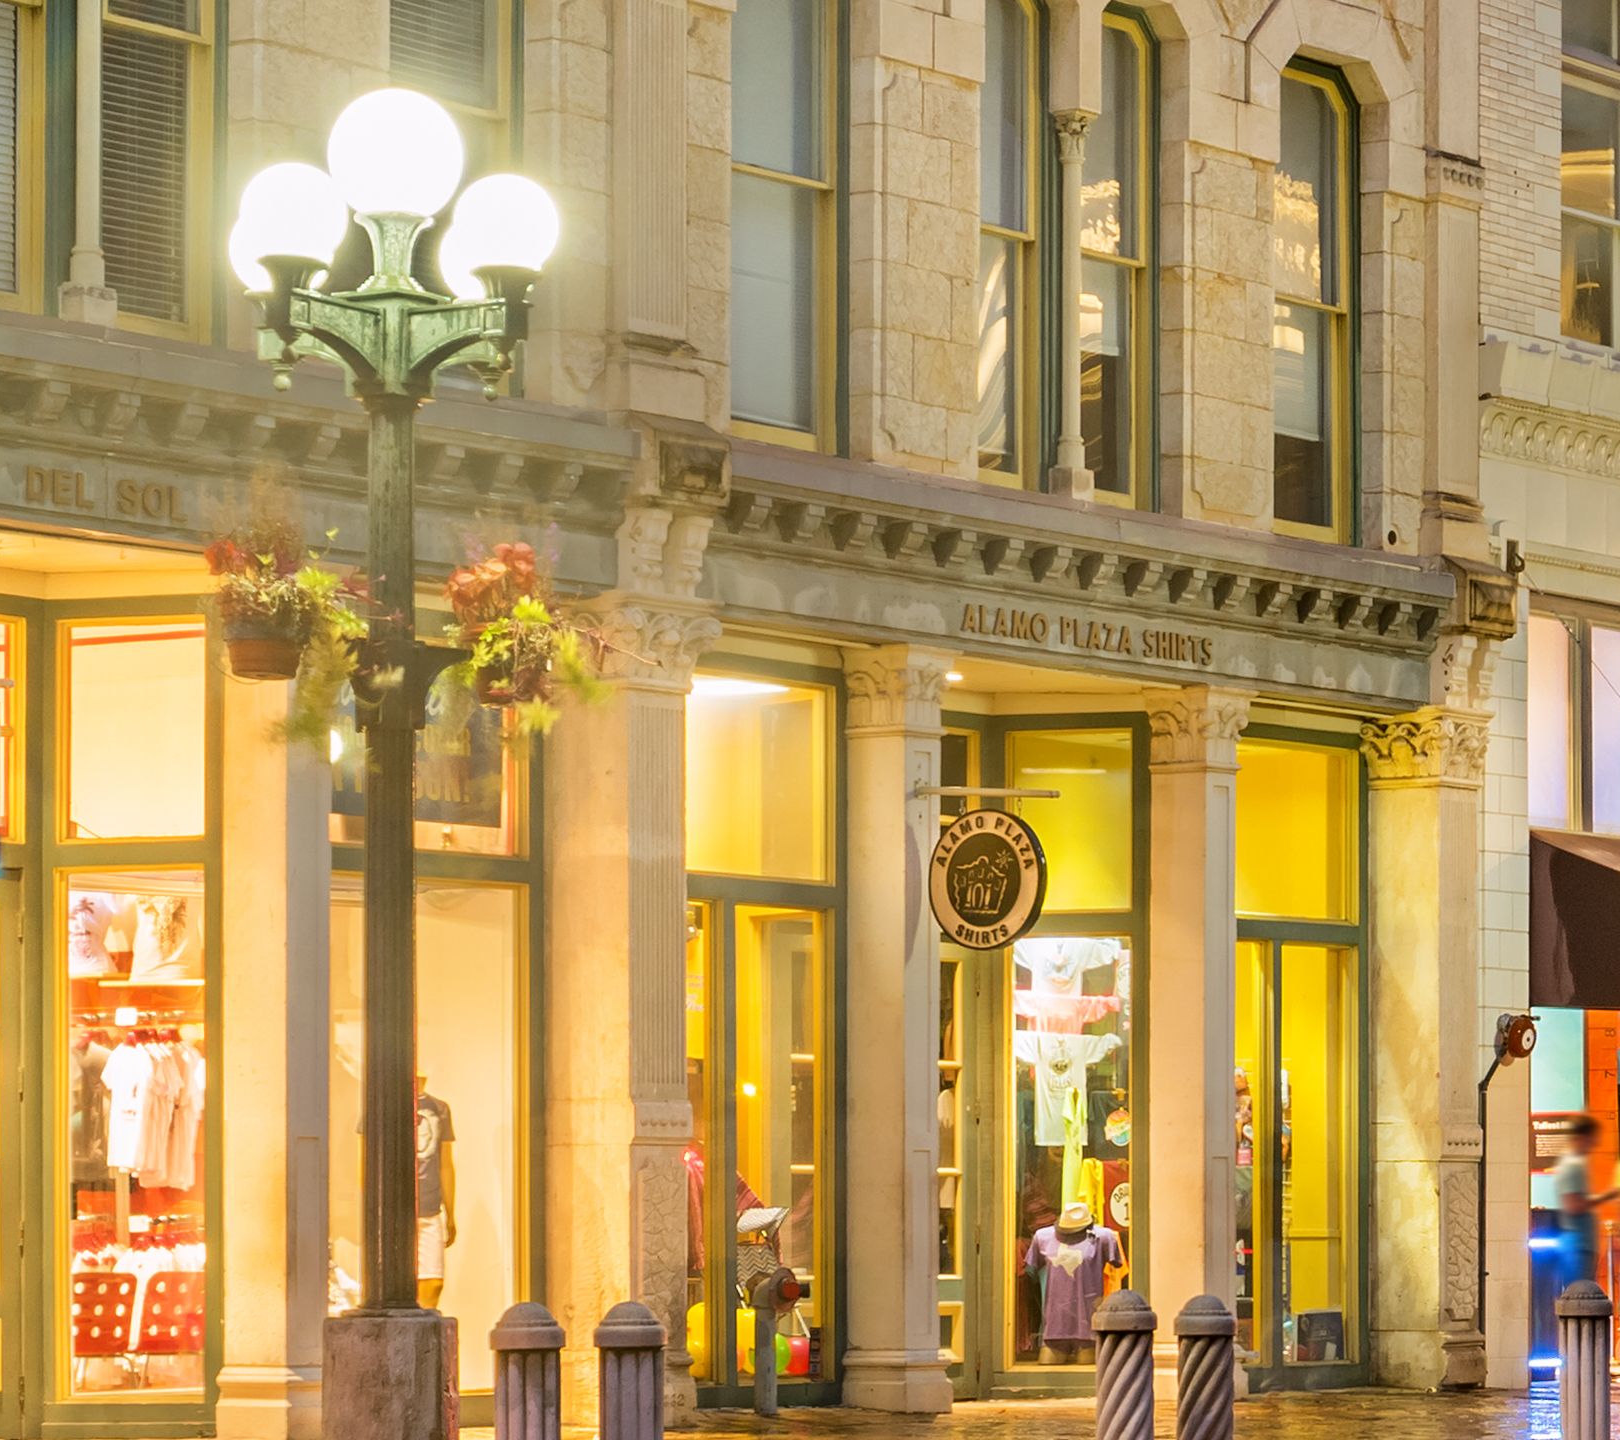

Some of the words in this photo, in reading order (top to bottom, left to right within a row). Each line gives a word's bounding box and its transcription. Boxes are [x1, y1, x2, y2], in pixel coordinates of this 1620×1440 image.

[26, 465, 94, 510] DEL
[116, 478, 188, 522] SOL
[963, 603, 1049, 644] ALAMO
[1060, 615, 1132, 656] PLAZA
[1142, 628, 1214, 666] SHIRTS
[936, 815, 984, 867] ALAMO
[994, 817, 1034, 869] PLAZA
[956, 925, 1008, 944] SHIRTS
